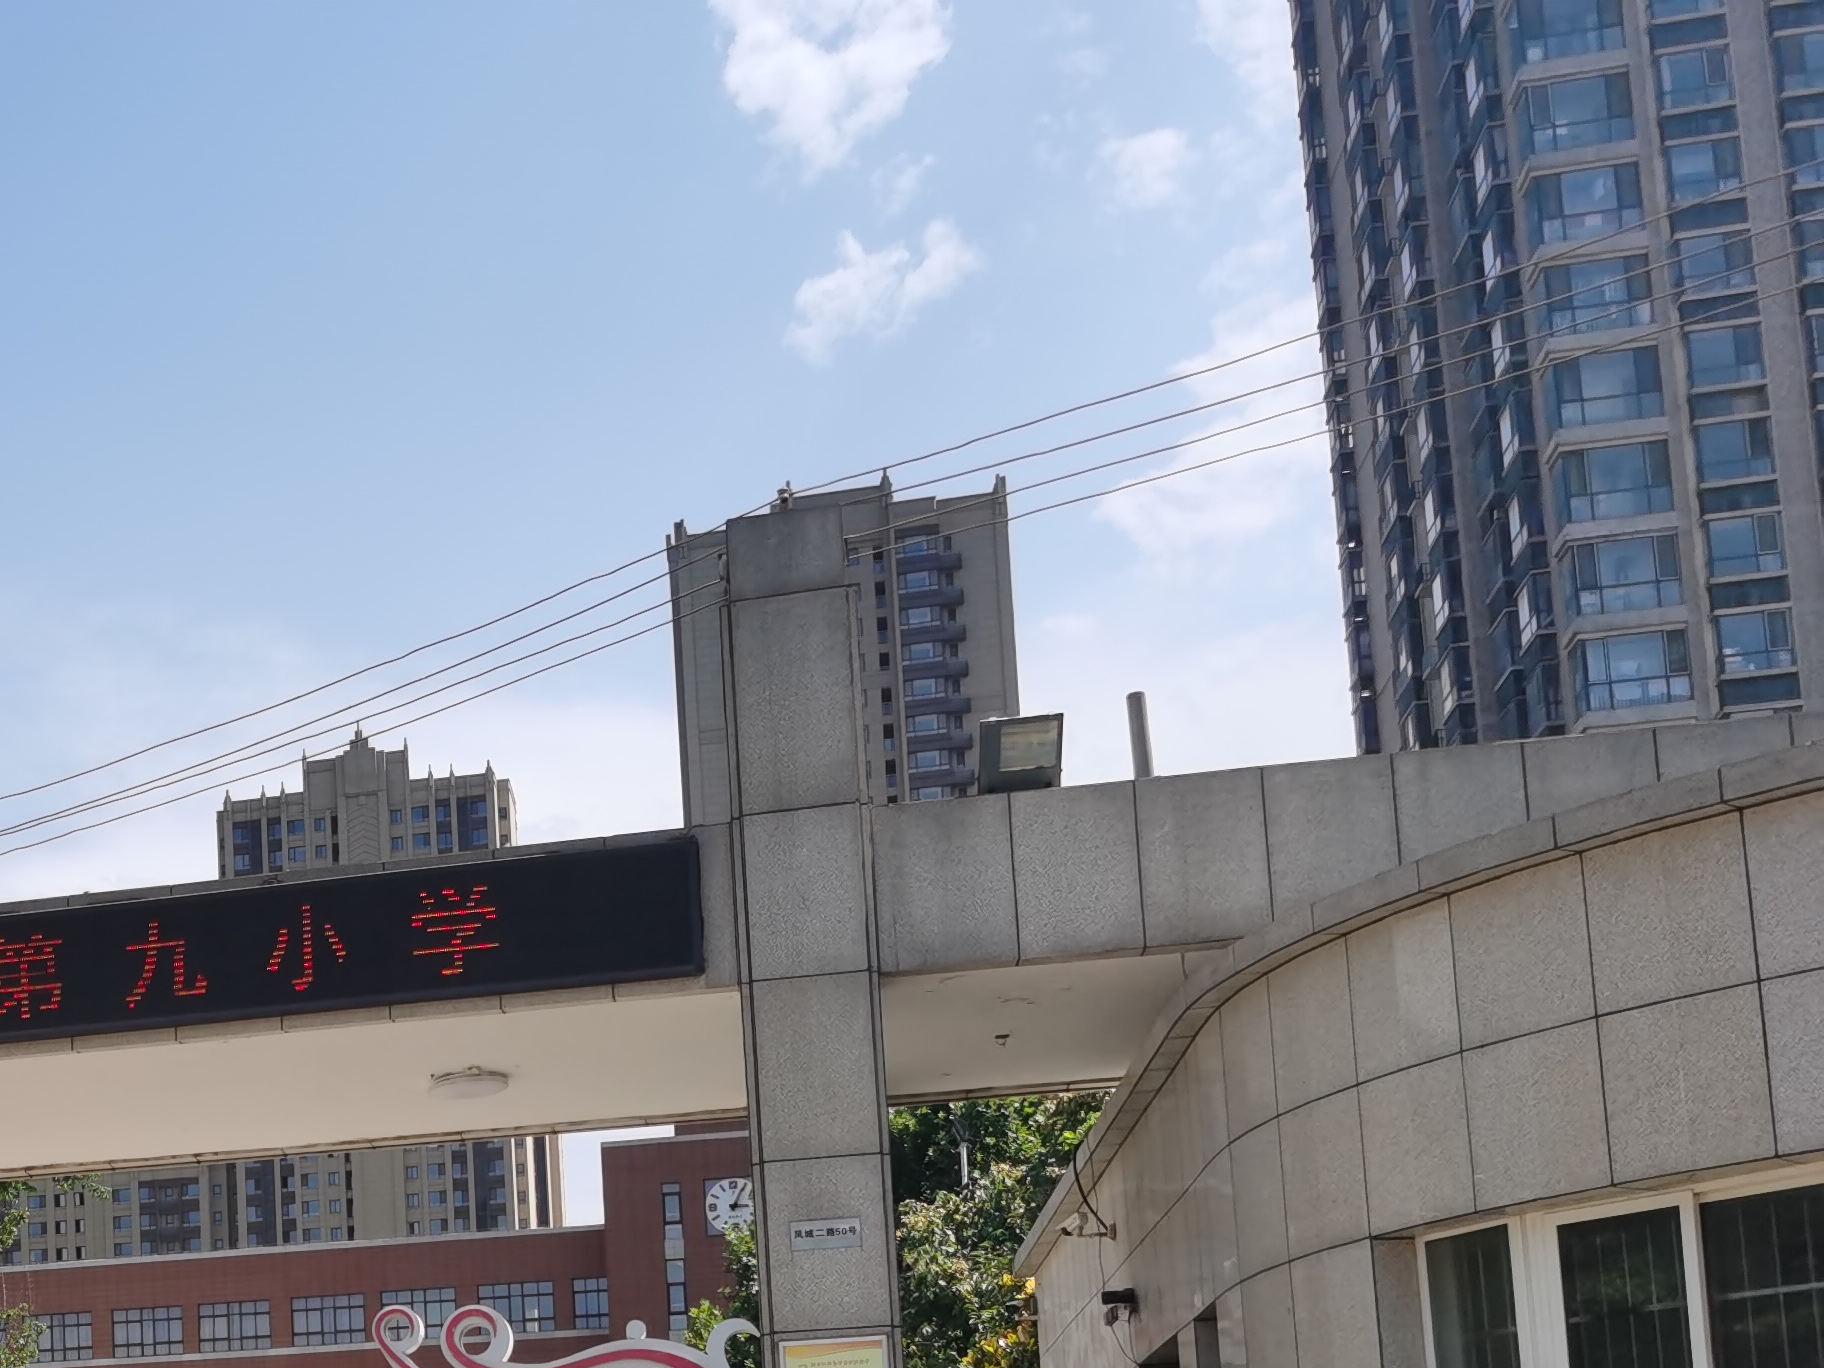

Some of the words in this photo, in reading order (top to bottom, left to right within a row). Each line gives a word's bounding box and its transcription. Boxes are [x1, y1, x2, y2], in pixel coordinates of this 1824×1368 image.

[794, 1226, 857, 1240] 凤城二路50号
